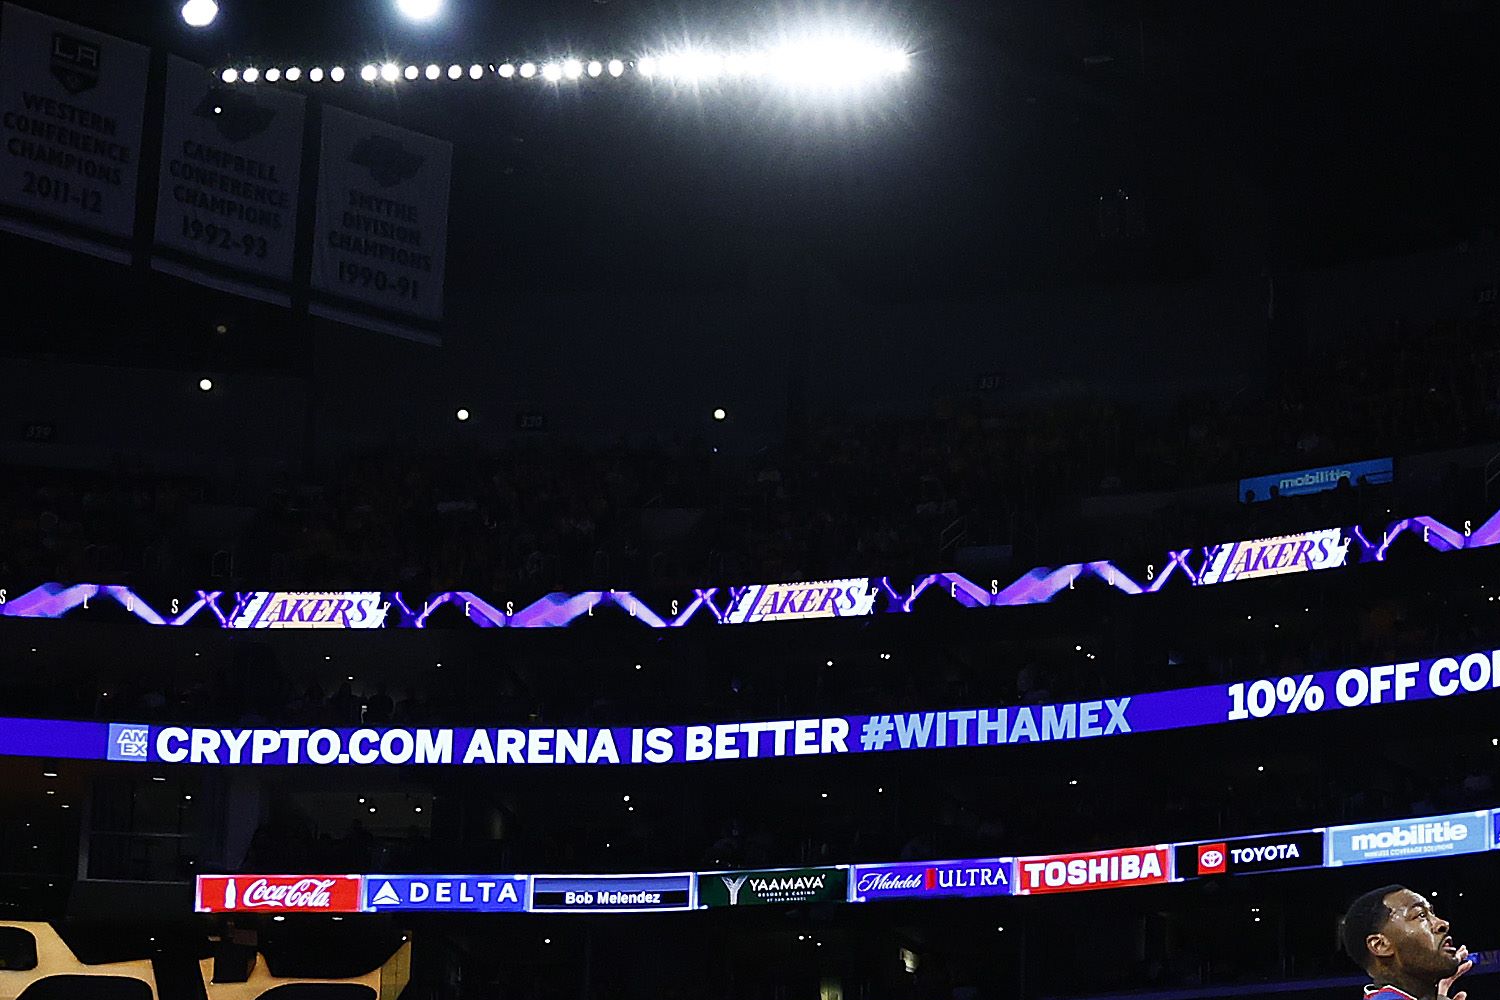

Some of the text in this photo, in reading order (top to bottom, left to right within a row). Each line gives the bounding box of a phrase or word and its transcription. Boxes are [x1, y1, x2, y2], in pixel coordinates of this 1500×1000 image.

[22, 91, 116, 135] WESTERN
[3, 111, 129, 163] CONFERENCE
[7, 137, 122, 186] CHAMPIONS
[182, 139, 280, 183] CAMPBELL
[22, 171, 101, 213] 2011-12
[169, 159, 289, 209] CONFERENCE
[173, 184, 282, 231] CHAMPIONS
[182, 215, 268, 258] 1992-93
[328, 230, 432, 272] CHAMPIONS
[338, 260, 419, 300] 1990-91
[1217, 536, 1335, 582] LAKERS
[250, 592, 373, 628] LAKERS
[743, 583, 865, 622] LAKERS
[1228, 674, 1325, 720] 10%
[1335, 662, 1421, 708] OFF
[156, 697, 1133, 765] CRYPTO.COM ARENA IS BETTER #WITHAMEX
[1230, 843, 1300, 864] TOYOTA
[1351, 820, 1468, 851] mobilitie
[857, 867, 1009, 892] Michelob ULTRA
[1023, 851, 1162, 890] TOSHIBA
[243, 878, 336, 907] Coca-Cola
[410, 882, 518, 903] DELTA
[565, 891, 661, 905] Bob Melendez
